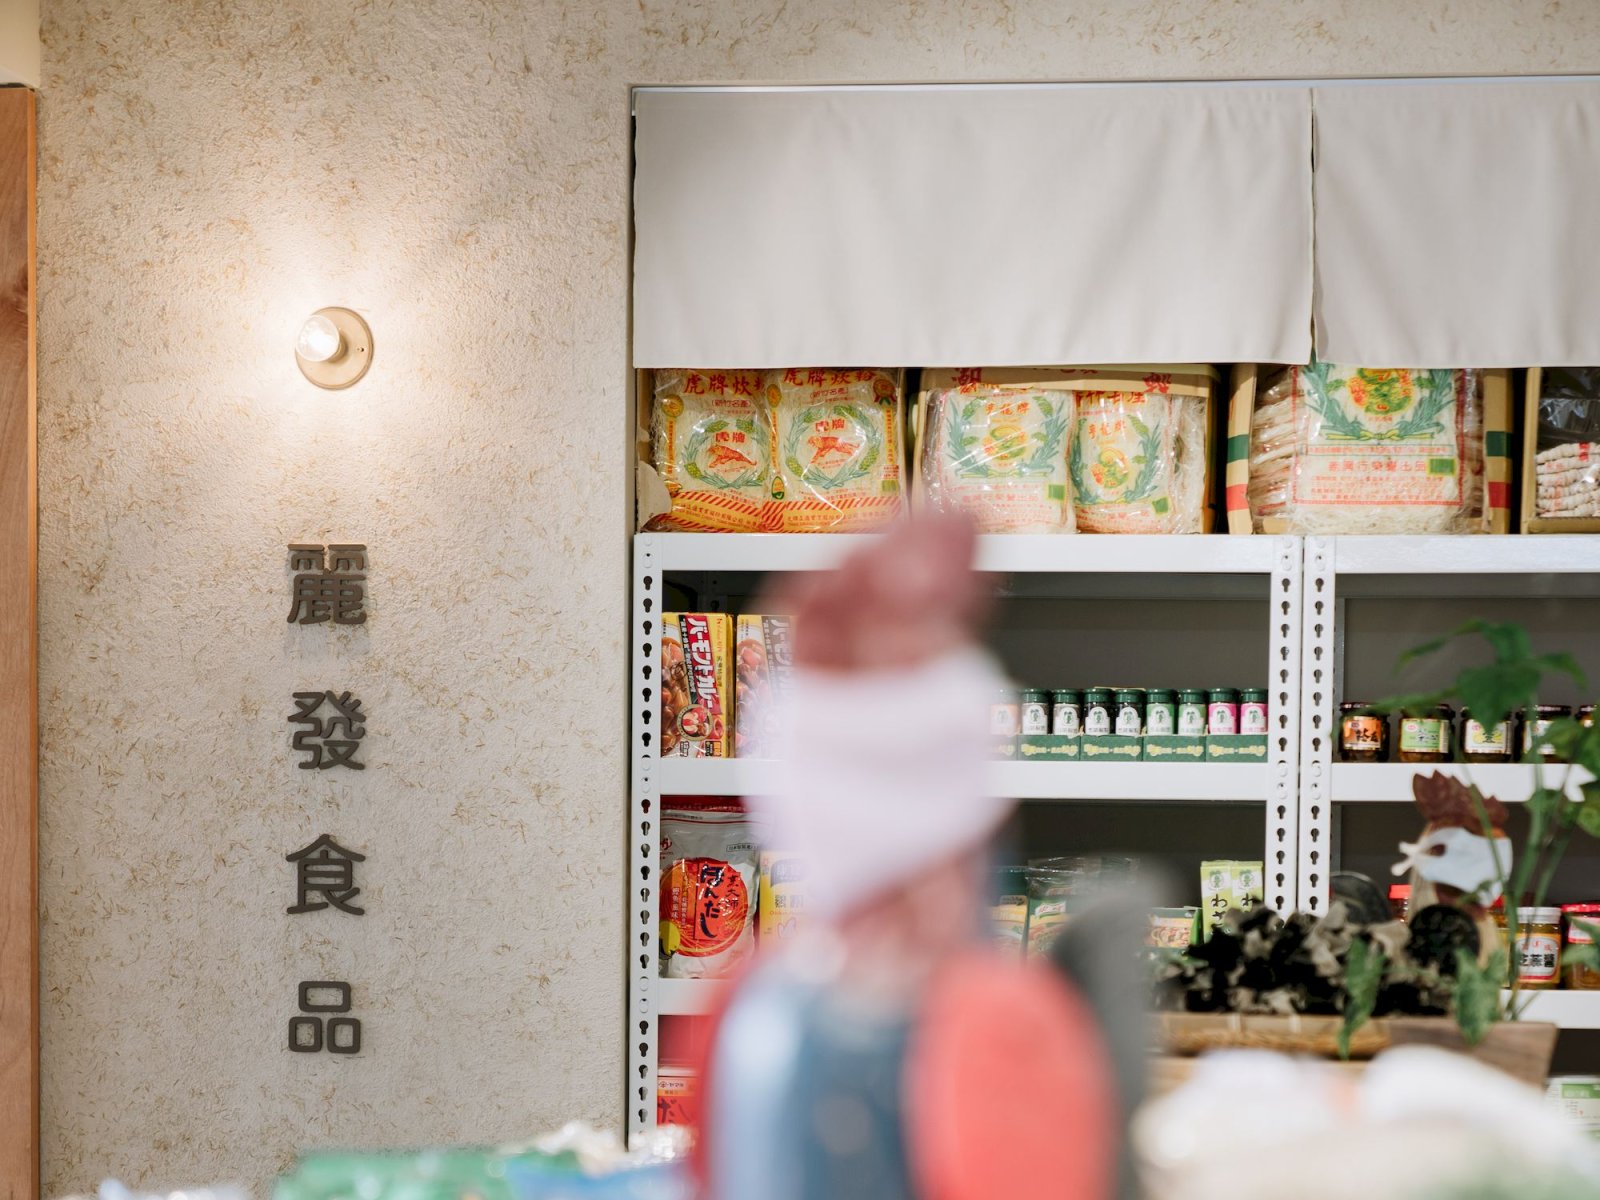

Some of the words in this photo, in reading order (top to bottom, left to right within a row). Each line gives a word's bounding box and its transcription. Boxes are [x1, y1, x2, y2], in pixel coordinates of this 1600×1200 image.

[287, 543, 368, 1054] 麗發食品
[688, 617, 717, 709] バーモントカレー
